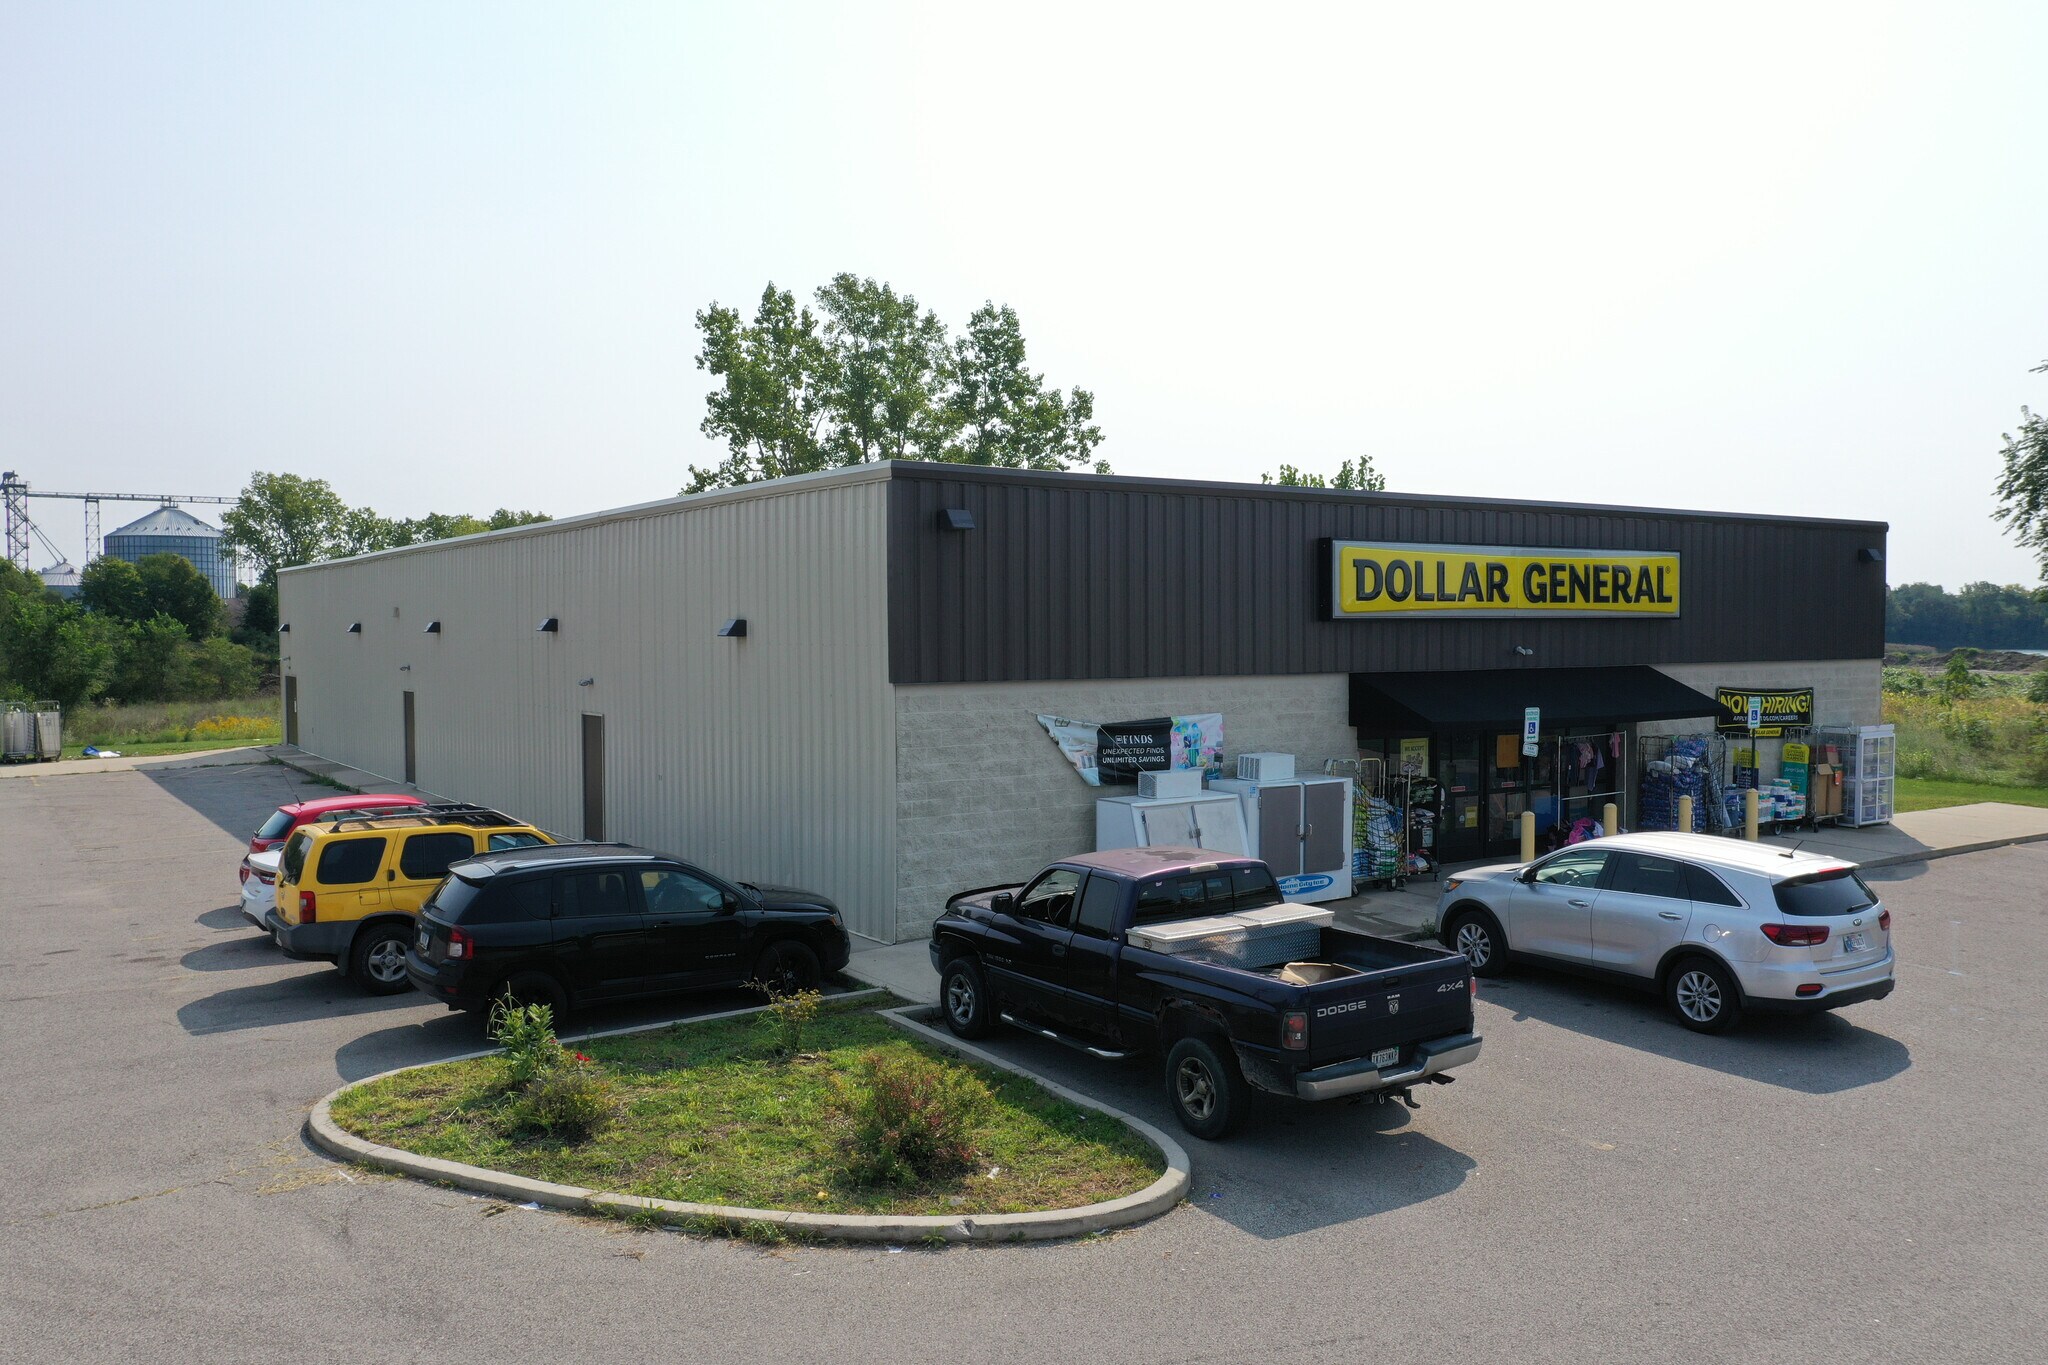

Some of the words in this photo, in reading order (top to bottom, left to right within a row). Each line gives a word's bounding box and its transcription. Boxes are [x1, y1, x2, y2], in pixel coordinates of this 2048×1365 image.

[1352, 558, 1510, 603] DOLLAR
[1522, 563, 1673, 604] GENERAL
[1761, 695, 1811, 713] HIRING!
[1122, 734, 1153, 745] FINDS
[1102, 747, 1145, 755] UNEXPECTED
[1102, 756, 1137, 764] UNLIMITED
[1317, 1000, 1367, 1018] DODGE
